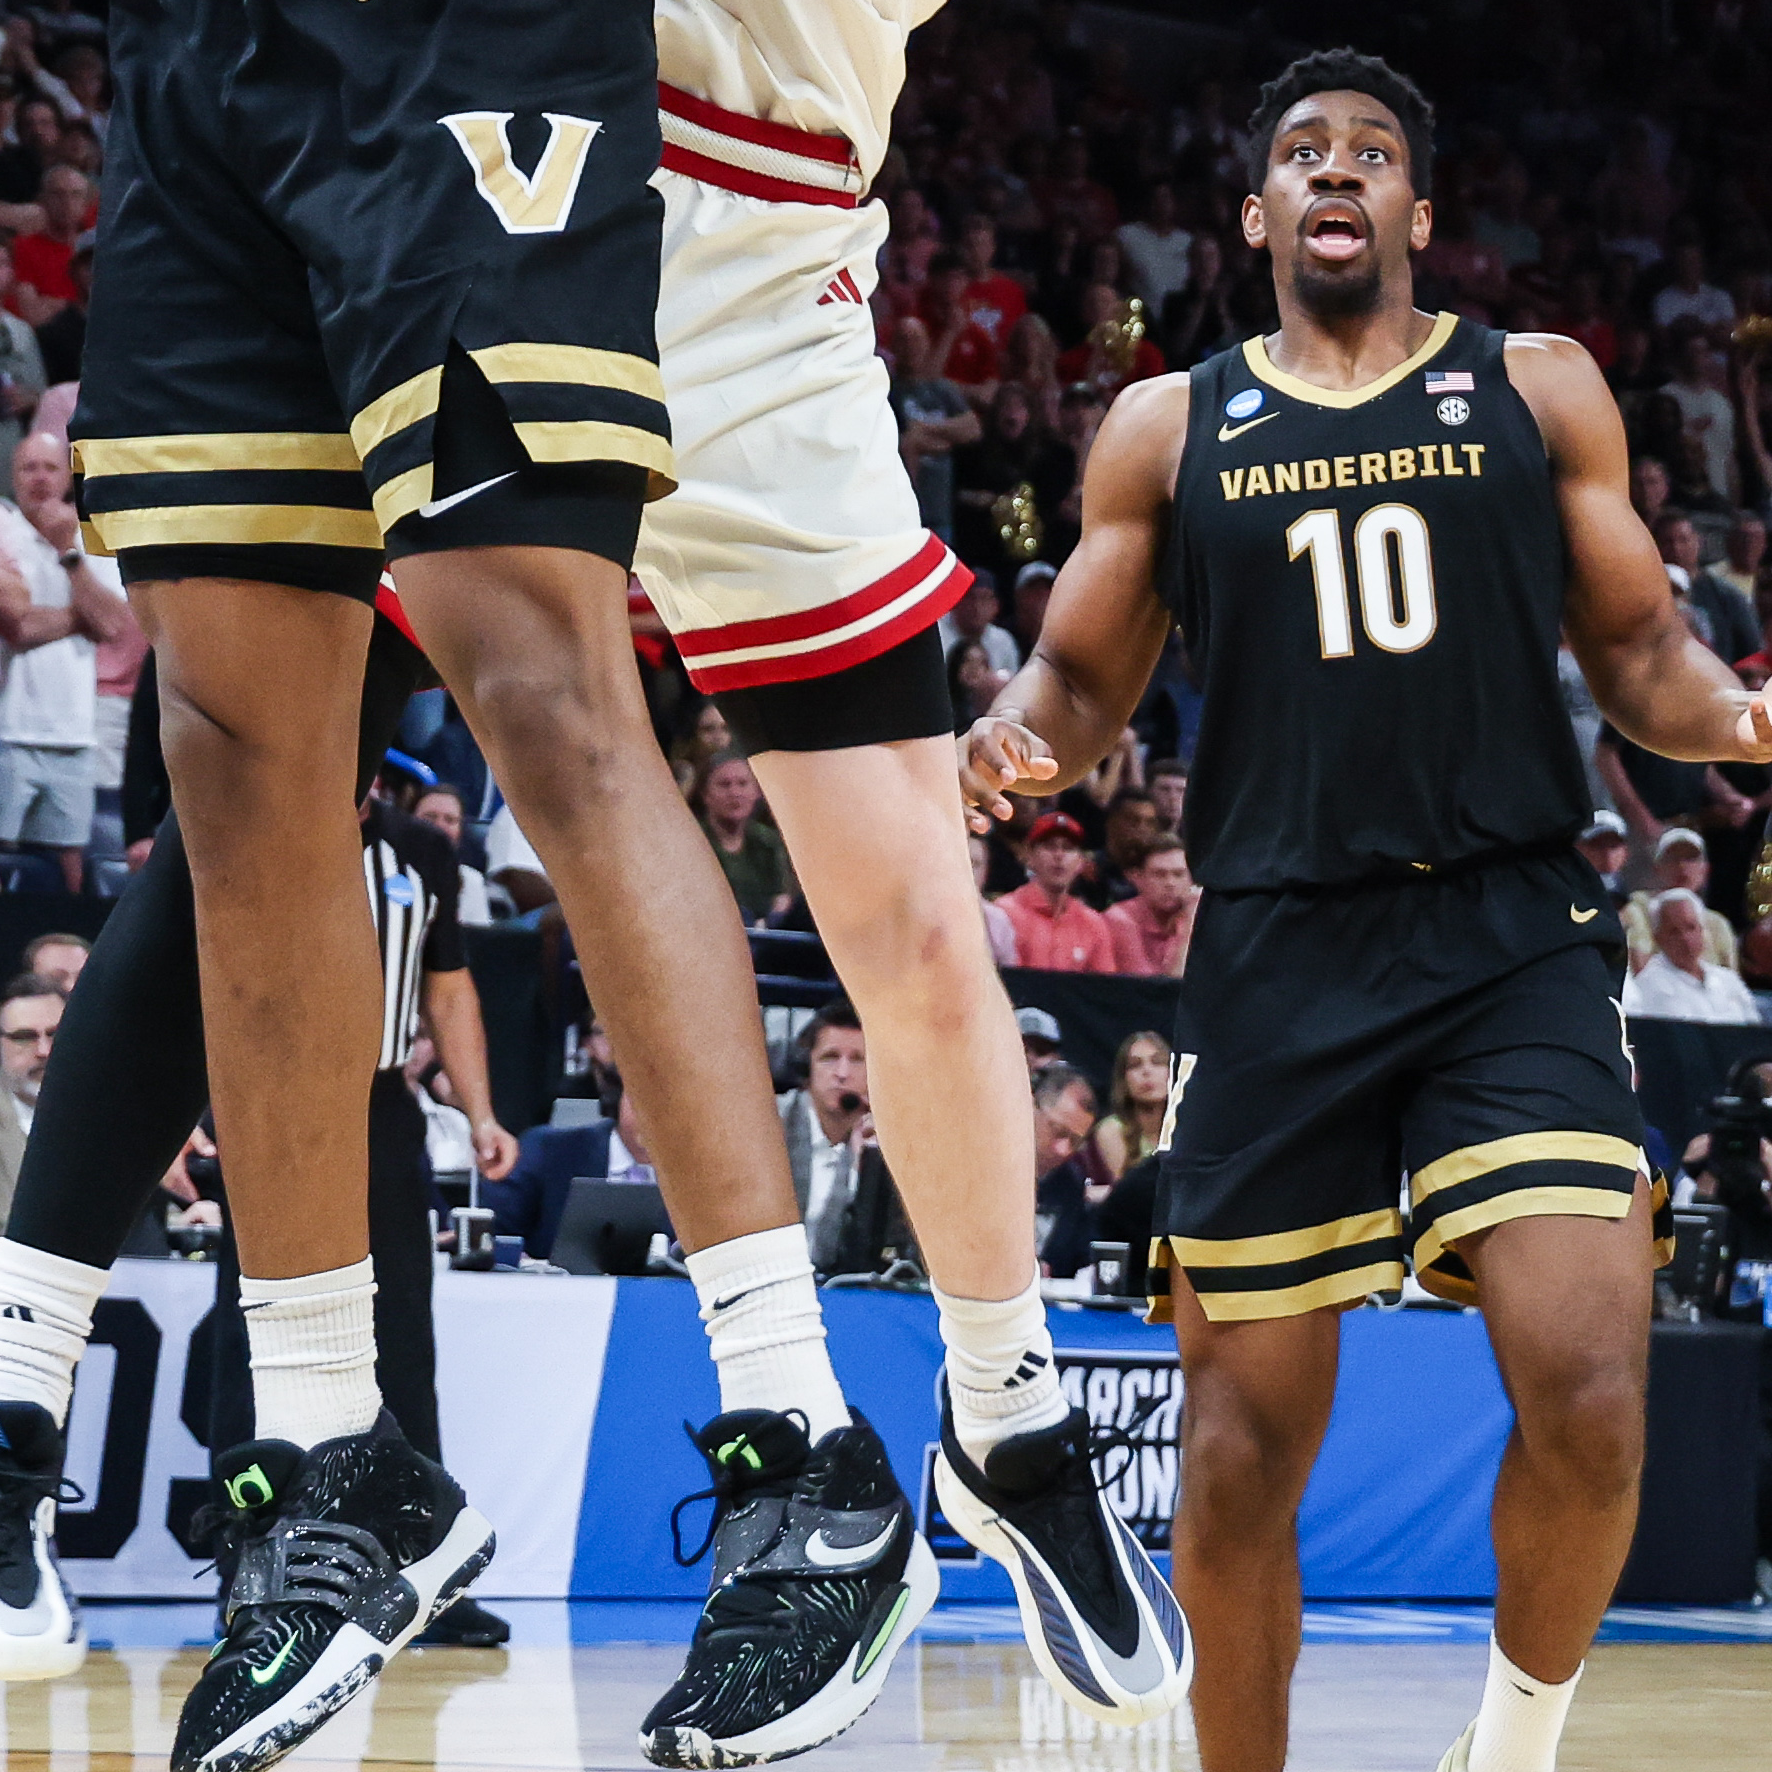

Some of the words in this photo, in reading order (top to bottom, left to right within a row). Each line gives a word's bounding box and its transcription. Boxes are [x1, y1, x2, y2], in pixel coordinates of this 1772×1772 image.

[436, 111, 605, 235] V
[1218, 443, 1486, 501] VANDERBILT
[1285, 502, 1437, 660] 10
